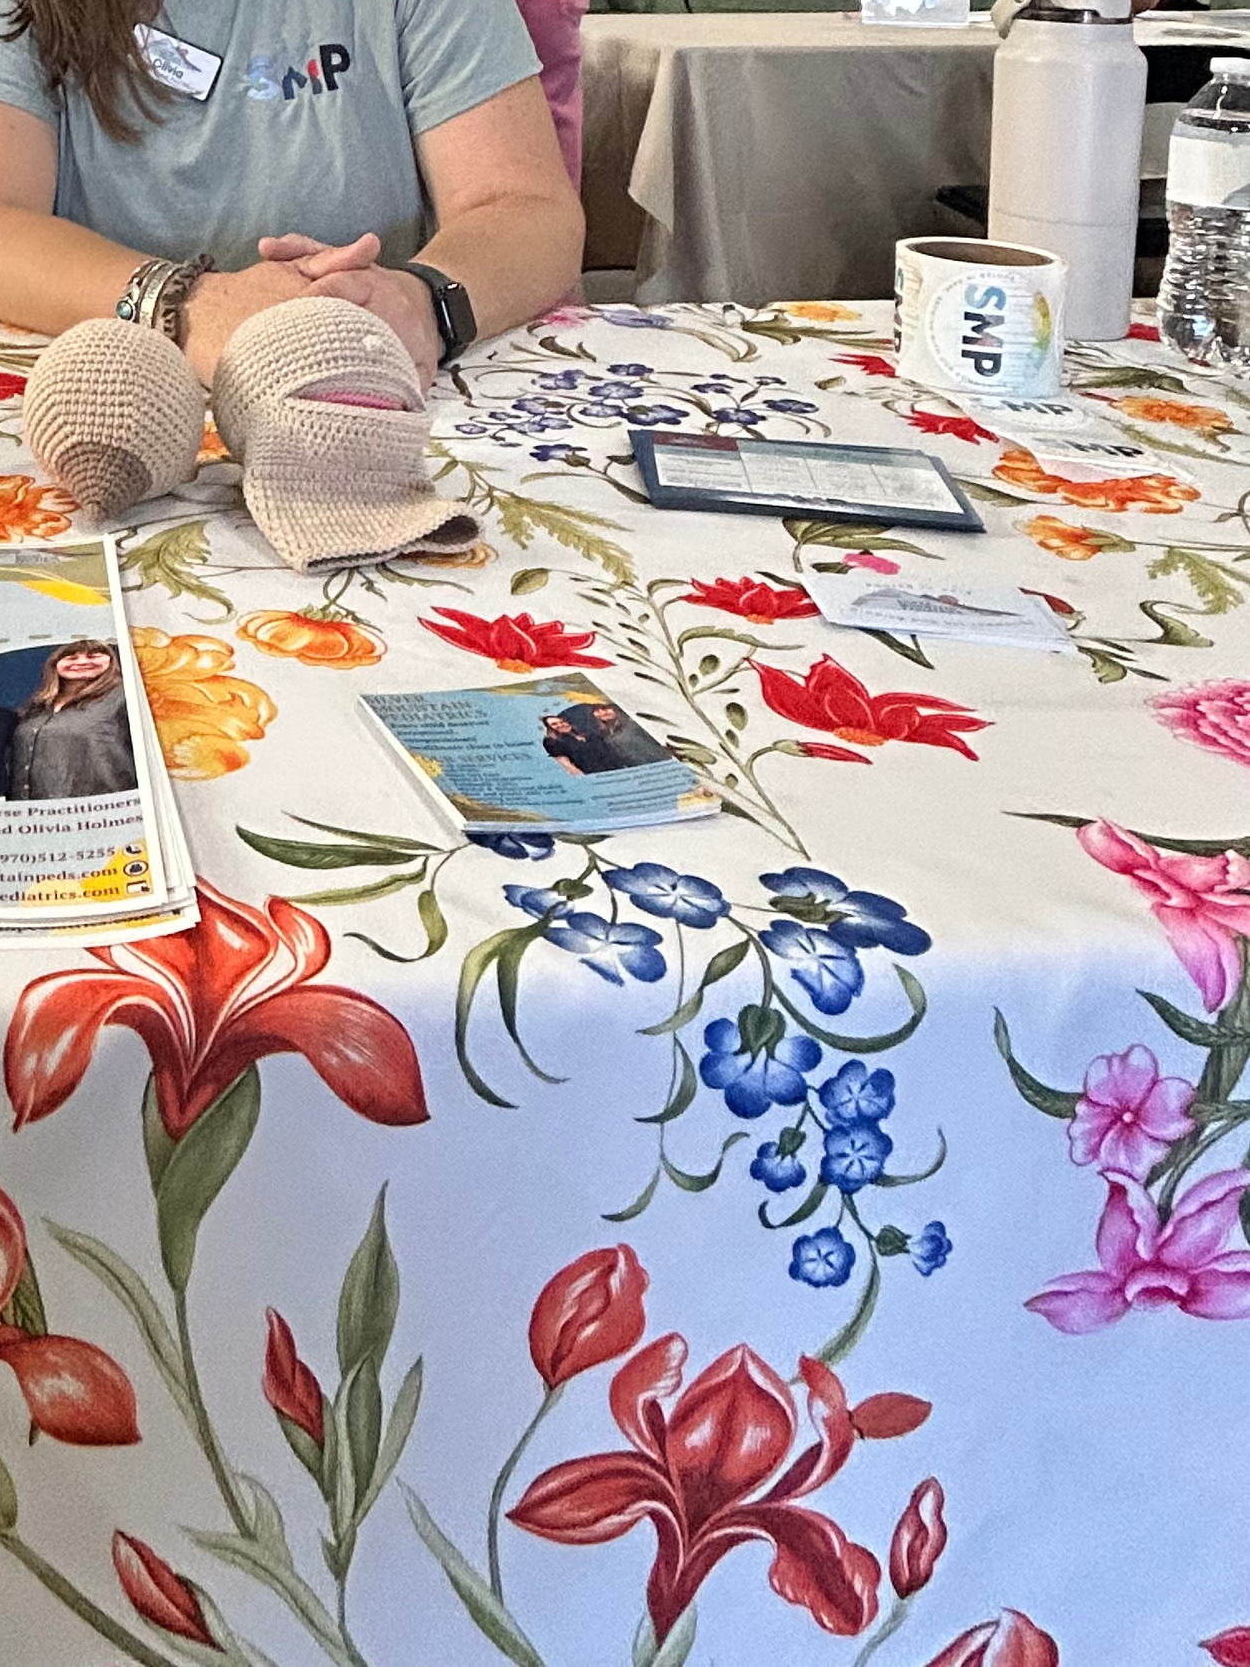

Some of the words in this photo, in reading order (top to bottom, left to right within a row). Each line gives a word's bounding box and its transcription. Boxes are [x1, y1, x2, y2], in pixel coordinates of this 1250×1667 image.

[152, 58, 184, 79] Olivia
[961, 283, 1007, 378] SMP
[27, 797, 141, 817] Practitioners
[18, 821, 72, 835] Olivia
[77, 814, 144, 831] Holmes
